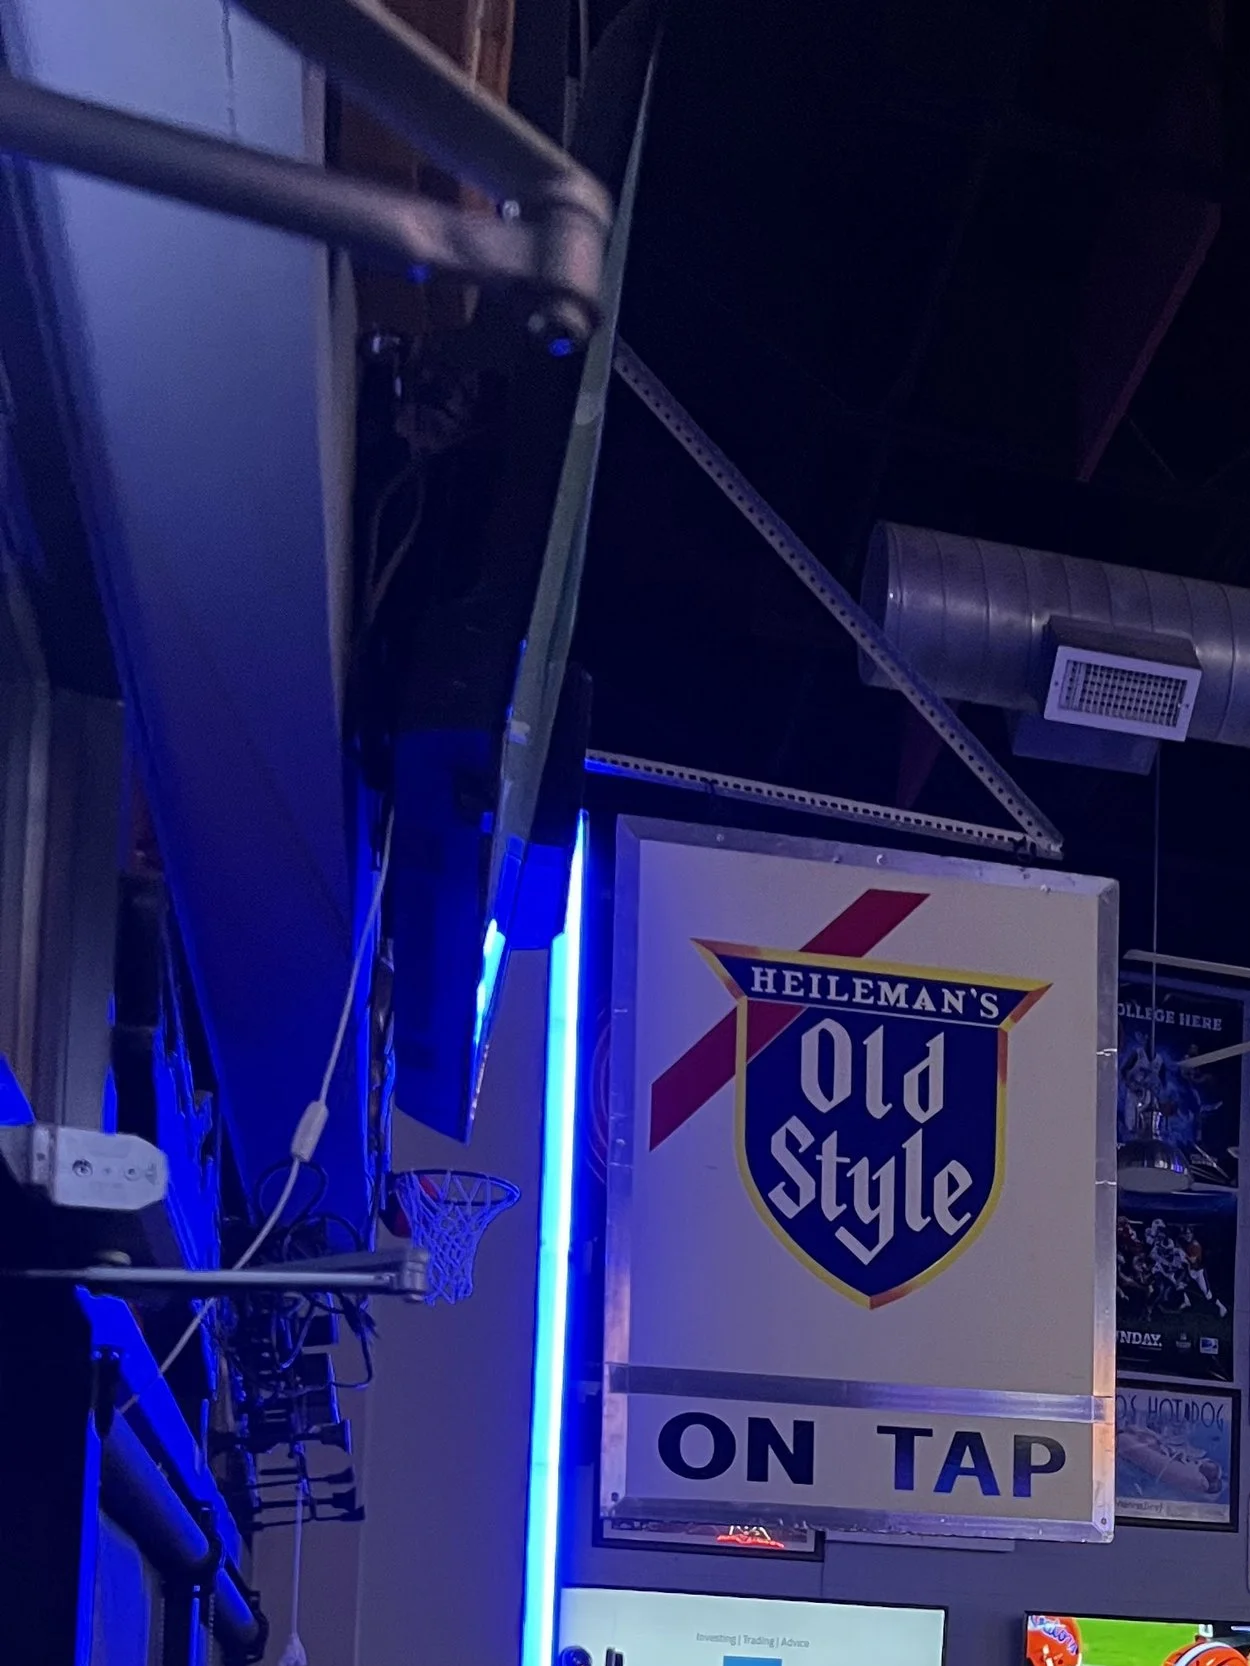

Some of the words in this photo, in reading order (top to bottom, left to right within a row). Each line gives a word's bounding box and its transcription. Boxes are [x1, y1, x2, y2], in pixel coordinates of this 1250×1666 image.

[751, 966, 1000, 1018] HEILEMAN'S
[1117, 1003, 1175, 1024] OLLEGE
[1179, 1013, 1222, 1031] HERE
[800, 1017, 946, 1124] Old
[767, 1116, 974, 1266] Style
[1117, 1331, 1163, 1348] NDAY.
[657, 1412, 814, 1486] ON
[876, 1426, 1067, 1498] TAP
[696, 1632, 737, 1646] Investing
[743, 1635, 775, 1648] Trading
[781, 1637, 810, 1648] Advice
